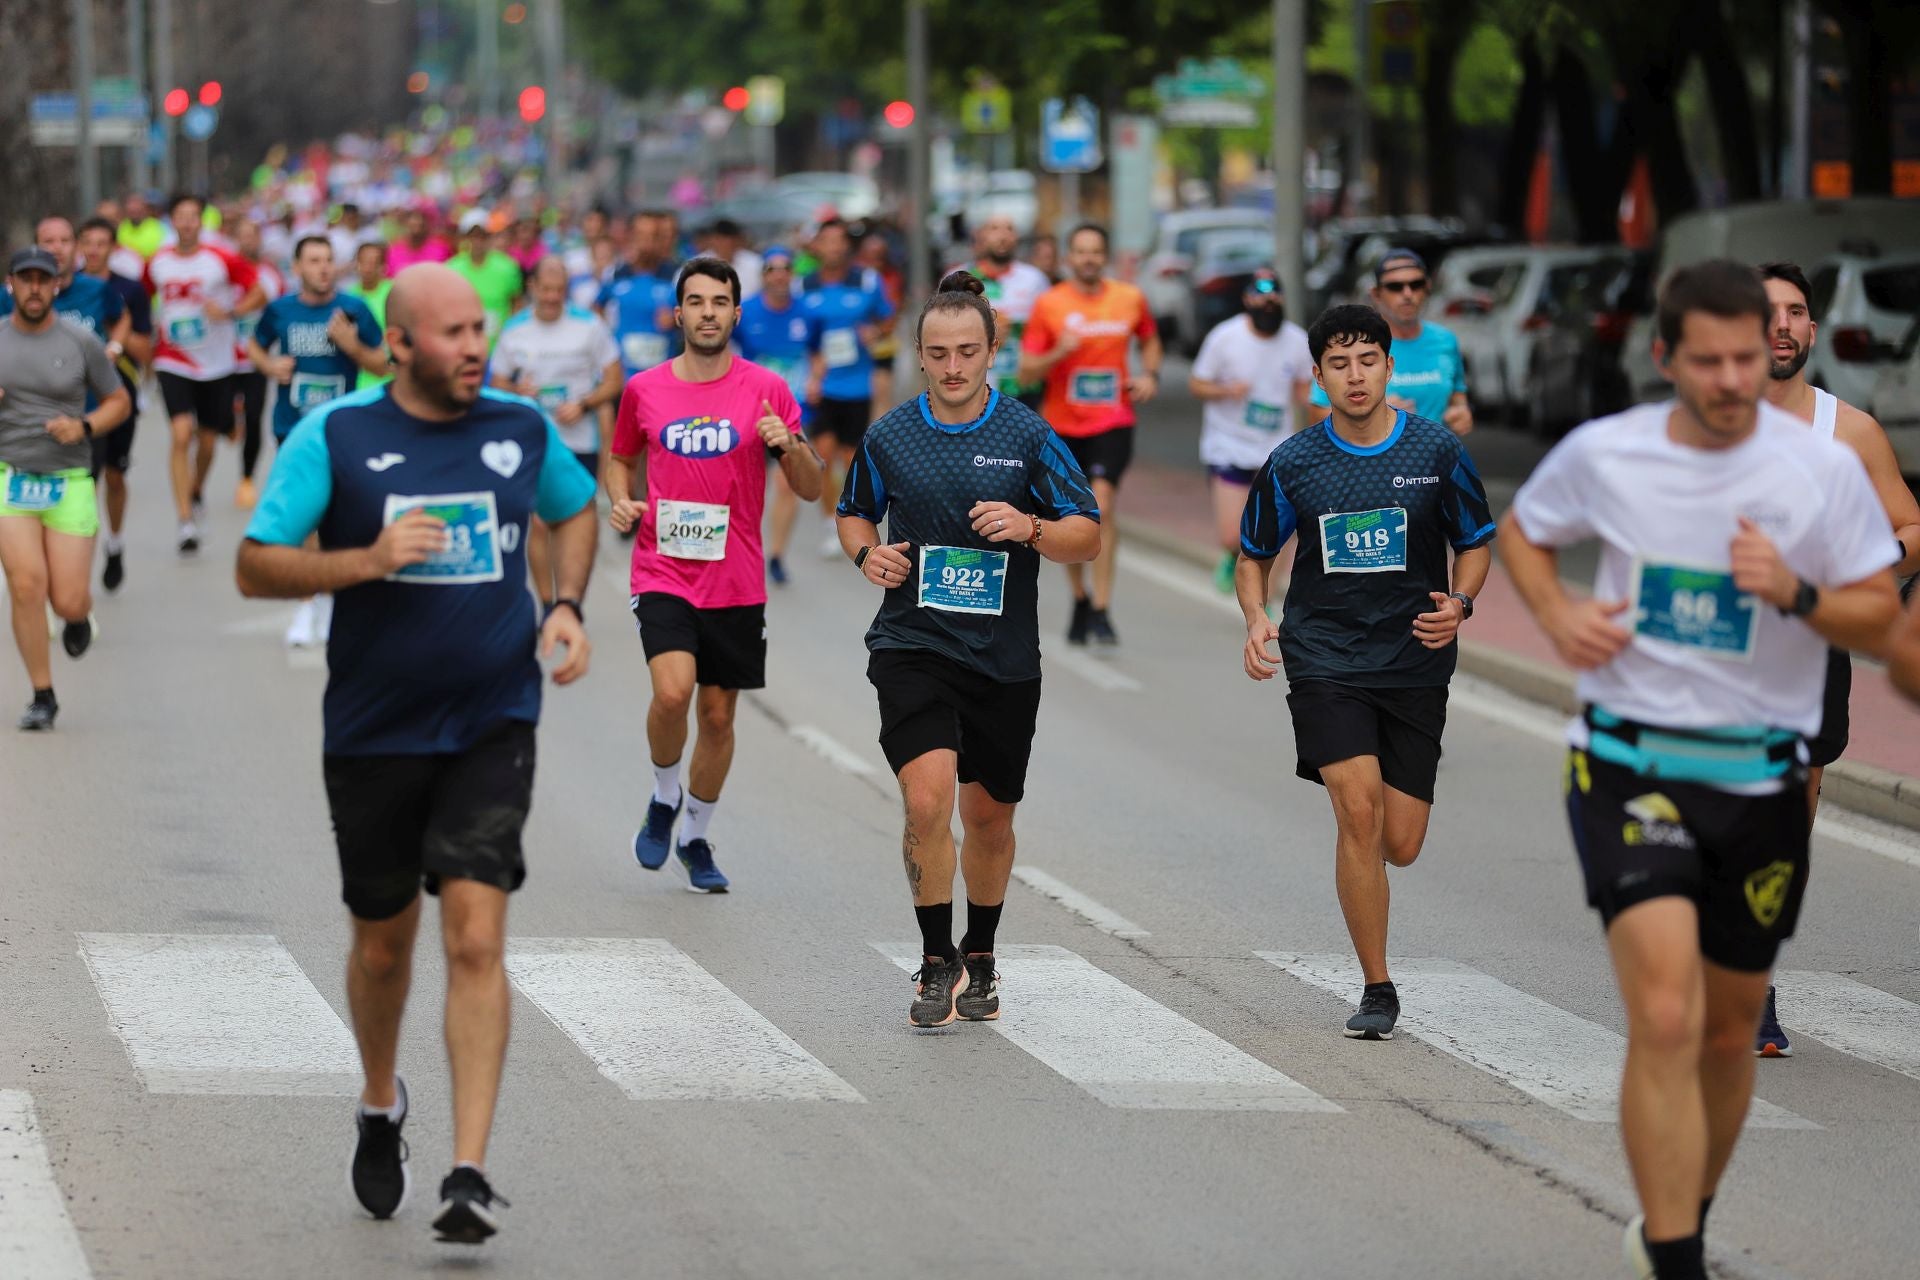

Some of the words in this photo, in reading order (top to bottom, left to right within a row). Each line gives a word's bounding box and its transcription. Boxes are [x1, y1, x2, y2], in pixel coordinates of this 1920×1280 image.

[667, 419, 731, 454] Fini
[669, 523, 714, 540] 2092
[1344, 528, 1390, 549] 918
[942, 566, 985, 587] 922
